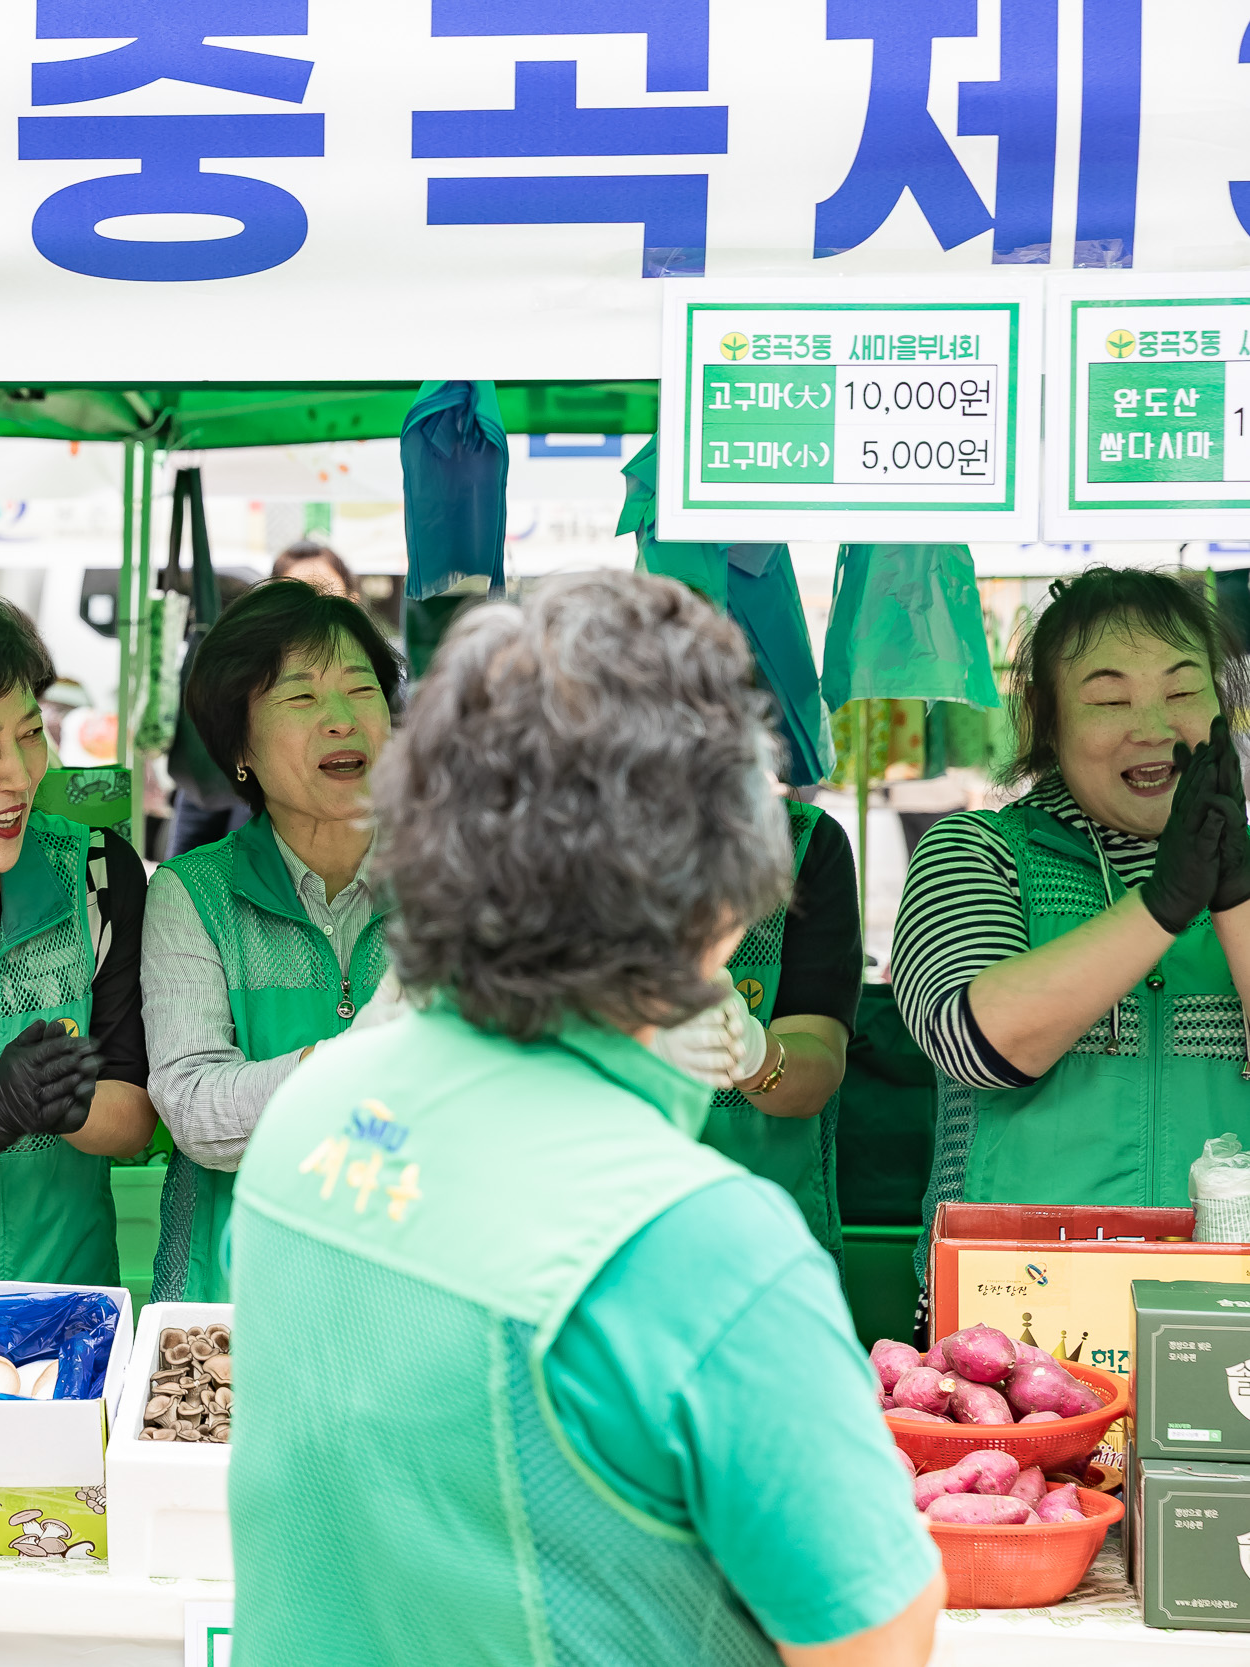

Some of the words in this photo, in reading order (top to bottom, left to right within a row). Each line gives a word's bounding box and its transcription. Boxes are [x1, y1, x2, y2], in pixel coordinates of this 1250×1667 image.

[17, 0, 1250, 283] 중곡제
[751, 334, 832, 361] 중곡3동
[848, 334, 980, 361] 새마을부녀회
[1138, 329, 1221, 358] 중곡3동
[708, 381, 833, 412] 고구마(大)
[844, 379, 991, 417] 10,000원
[1113, 387, 1201, 418] 완도산
[706, 440, 831, 471] 고구마(小)
[861, 439, 989, 477] 5,000원
[1099, 431, 1215, 462] 쌈다시마
